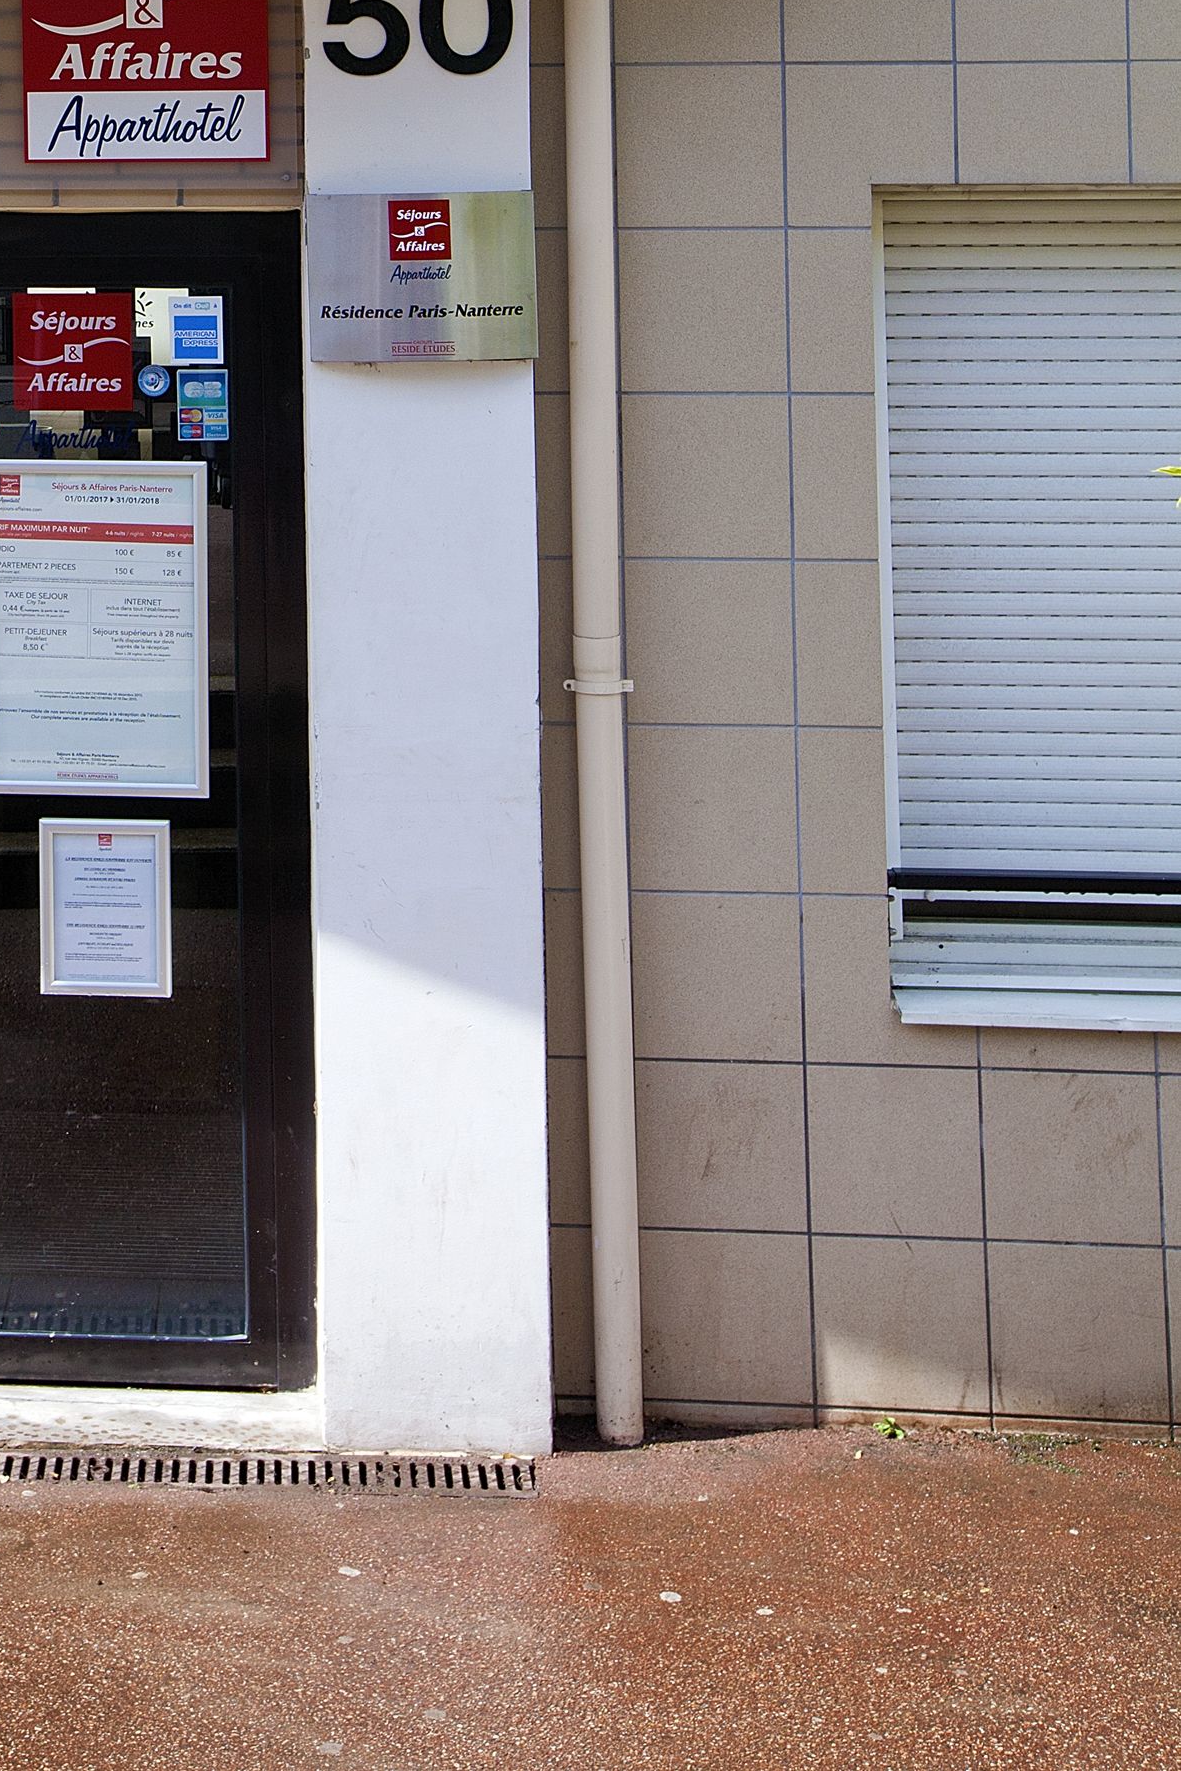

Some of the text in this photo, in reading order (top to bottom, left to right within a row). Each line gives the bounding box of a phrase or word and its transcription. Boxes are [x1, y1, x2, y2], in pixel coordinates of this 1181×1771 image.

[49, 41, 242, 80] Affaires
[48, 94, 245, 157] Apparthotel
[396, 209, 442, 223] Séjours
[416, 227, 423, 235] &
[396, 241, 445, 252] Affaires
[390, 264, 452, 285] Apparthotel
[321, 303, 524, 319] Résidence Paris-Nanterre
[30, 311, 116, 335] Séjours
[174, 330, 215, 338] AMERICAN
[183, 338, 218, 347] EXPRESS
[69, 346, 81, 360] &
[27, 372, 122, 392] Affaires
[51, 482, 80, 491] Séjours
[119, 484, 173, 493] Paris-Nanterre
[65, 495, 160, 505] 01/01/2017 31/01/2018
[11, 524, 51, 532] MAXIMUM
[4, 591, 24, 599] TAXE
[124, 598, 162, 606] INTERNET
[2, 604, 18, 612] 0,44
[4, 627, 67, 636] PETIT-DEJEUNER
[92, 627, 119, 636] Séjours
[120, 629, 157, 637] supérieurs
[165, 630, 175, 638] 28
